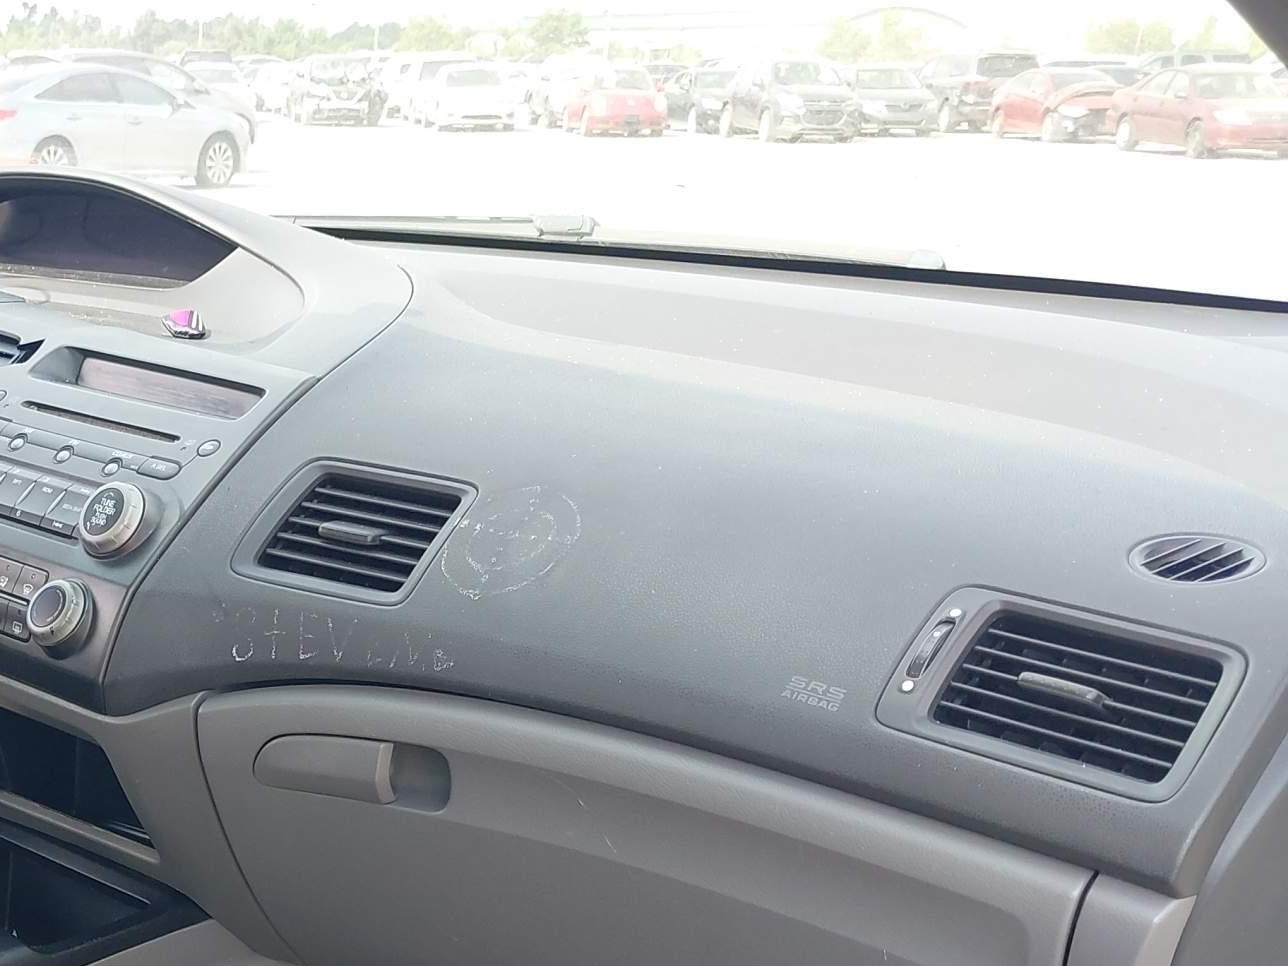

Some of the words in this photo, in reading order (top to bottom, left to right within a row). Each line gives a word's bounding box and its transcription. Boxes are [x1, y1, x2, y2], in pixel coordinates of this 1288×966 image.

[93, 503, 116, 515] FOLDER
[101, 497, 116, 508] TUNE
[789, 675, 847, 700] SRS
[780, 689, 840, 712] AIRBAG
